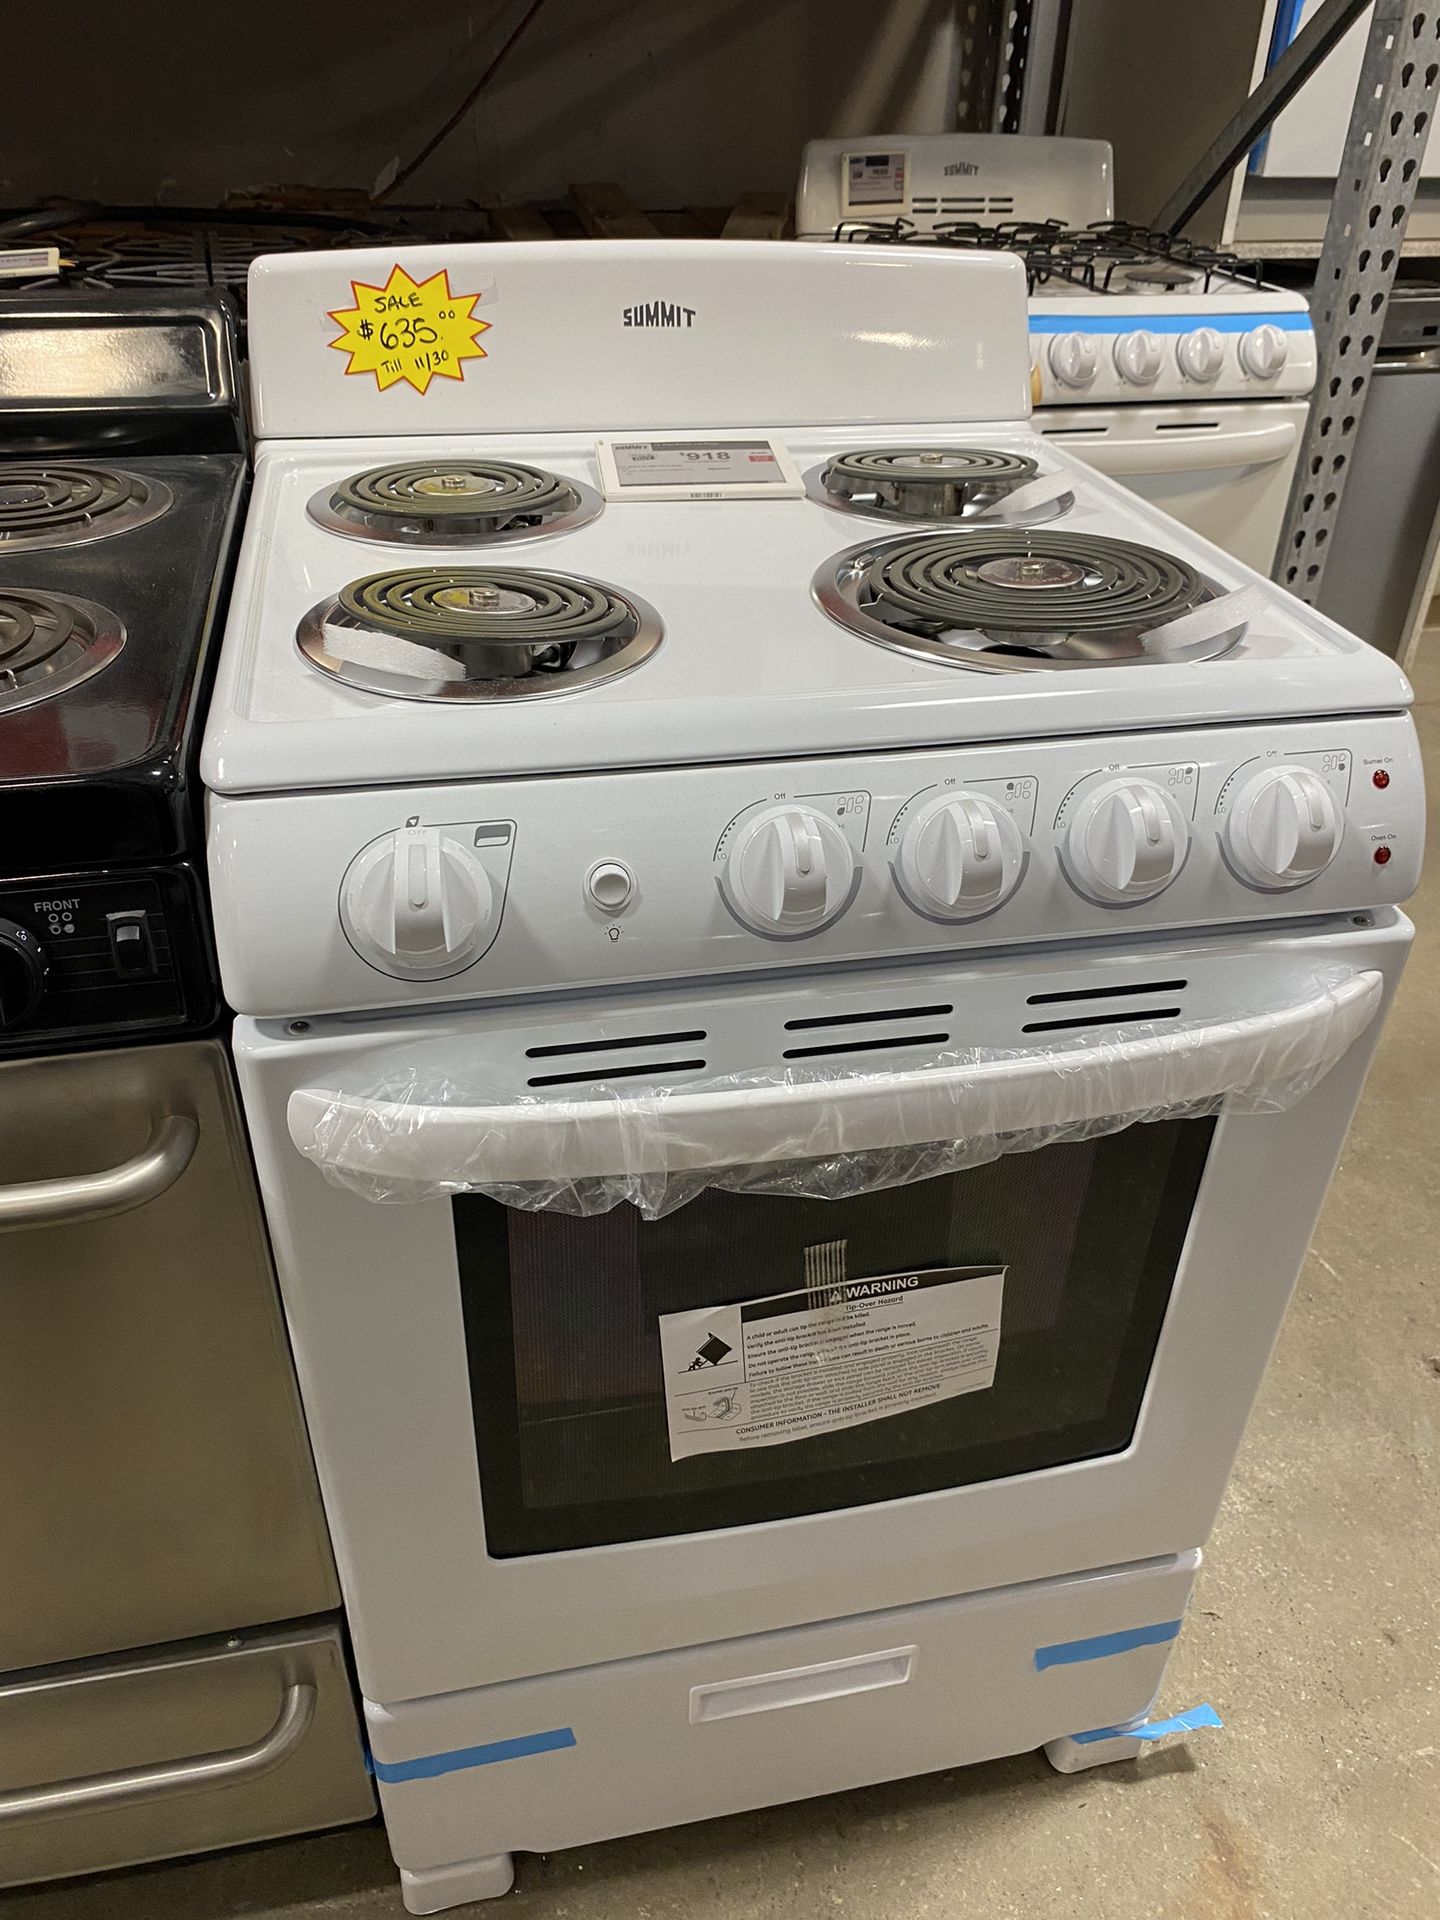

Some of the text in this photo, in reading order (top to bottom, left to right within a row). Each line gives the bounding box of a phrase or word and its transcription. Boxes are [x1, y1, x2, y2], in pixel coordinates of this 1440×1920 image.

[374, 292, 423, 314] SALE
[623, 300, 696, 328] SUMMIT
[414, 349, 449, 373] 11/30
[773, 792, 786, 800] Off
[33, 898, 81, 913] FRONT
[846, 1277, 919, 1299] WARNING
[845, 1295, 904, 1311] Tip-Over Hazard
[748, 1351, 766, 1359] Ensure
[736, 1422, 774, 1435] CONSUMER
[775, 1411, 822, 1427] INFORMATION
[842, 1400, 876, 1412] INSTALLER
[878, 1394, 897, 1403] SHALL
[898, 1390, 913, 1398] NOT
[914, 1383, 941, 1394] REMOVE
